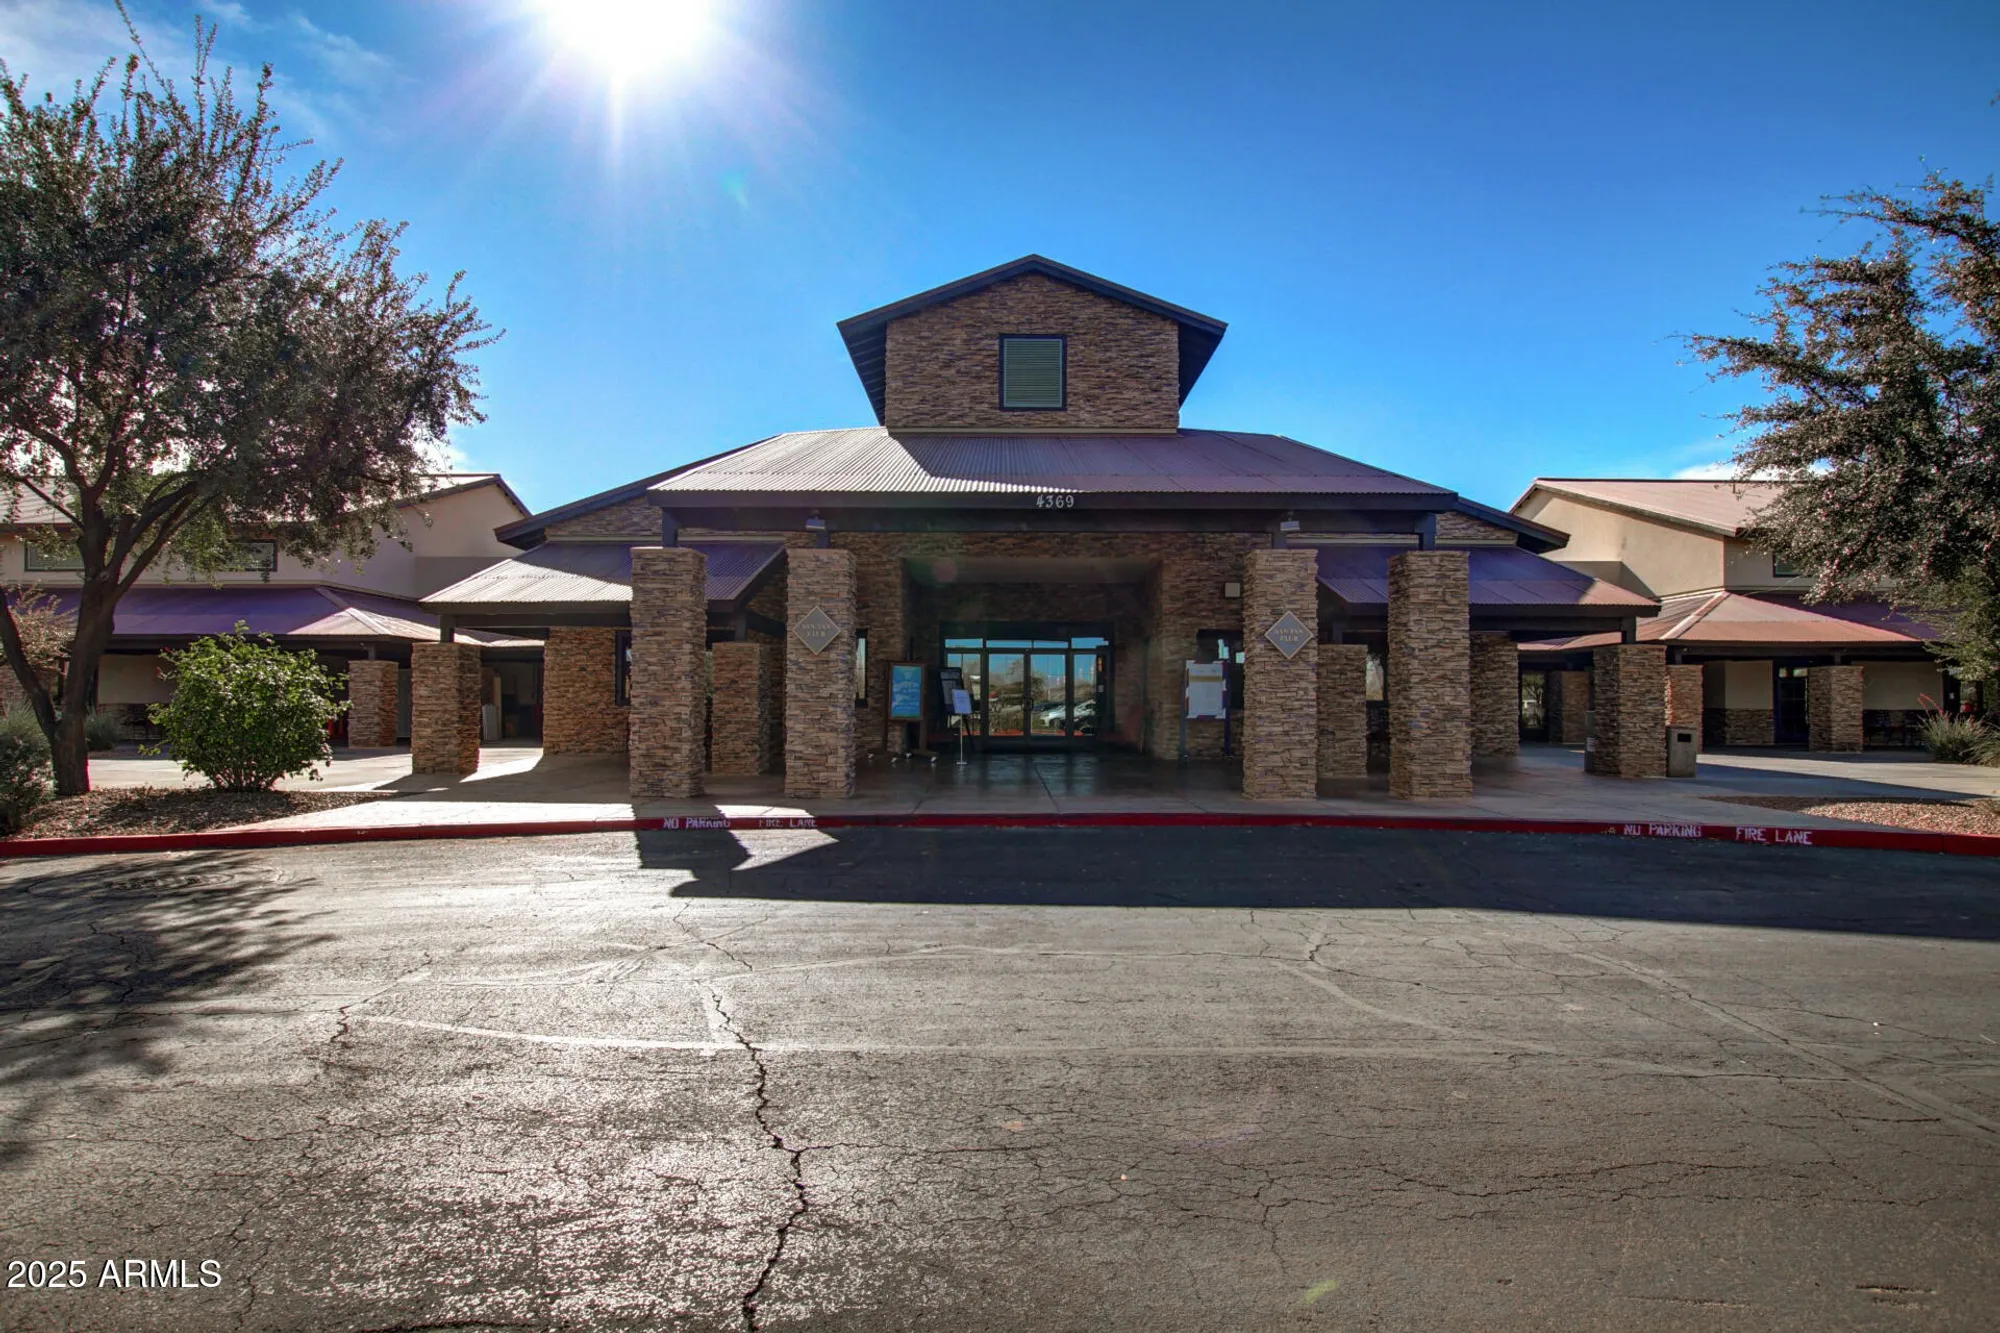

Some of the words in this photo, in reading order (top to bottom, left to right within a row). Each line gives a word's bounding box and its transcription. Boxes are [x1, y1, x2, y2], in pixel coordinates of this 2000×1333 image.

[1036, 494, 1075, 508] 4369
[663, 817, 679, 829] NO
[685, 817, 731, 829] PARKING
[759, 817, 782, 828] FIRE
[789, 817, 818, 828] LANE
[1648, 823, 1702, 837] PARKING
[1735, 826, 1767, 841] FIRE
[1775, 829, 1812, 845] LANE
